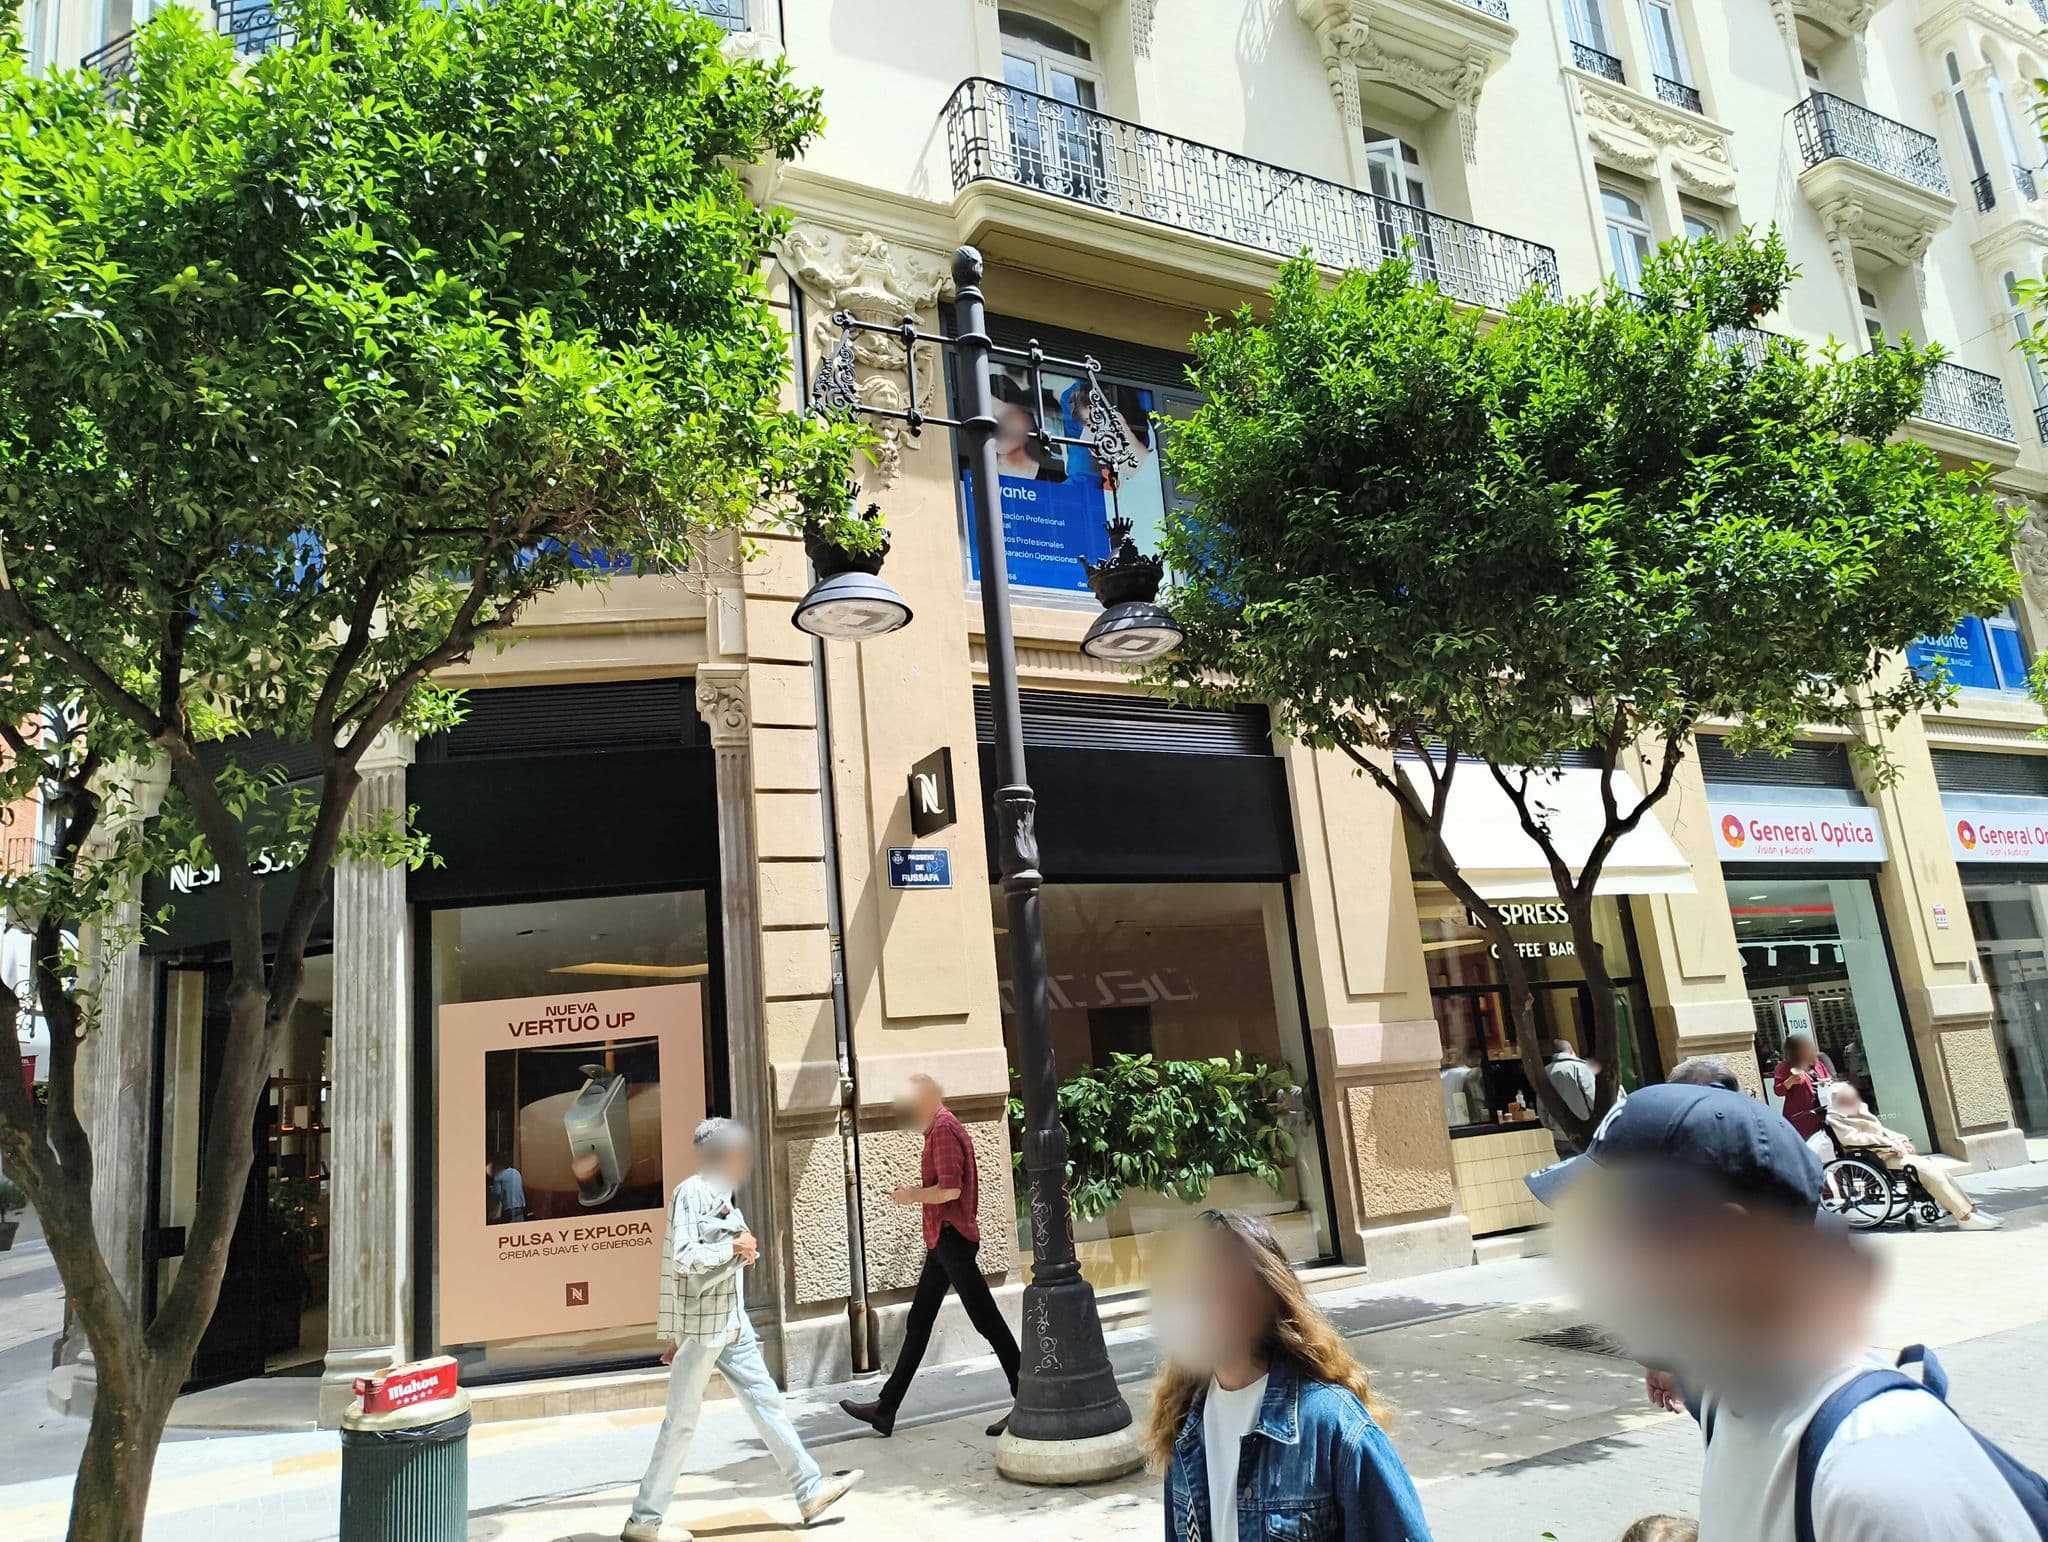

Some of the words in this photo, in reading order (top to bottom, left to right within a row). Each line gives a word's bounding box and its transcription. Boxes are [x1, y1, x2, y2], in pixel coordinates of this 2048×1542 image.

[1750, 820, 1818, 842] General
[1979, 825, 2033, 844] General
[901, 873, 940, 882] RUSSAFA
[1548, 941, 1576, 956] BAR
[545, 1002, 598, 1017] NUEVA
[508, 1015, 600, 1037] VERTUO
[605, 1012, 636, 1029] UP
[1789, 1018, 1808, 1029] TOUS
[498, 1232, 554, 1249] PULSA
[558, 1230, 570, 1242] Y
[574, 1222, 653, 1241] EXPLORA
[498, 1248, 541, 1261] CREMA
[542, 1244, 579, 1256] SUAVE
[581, 1243, 590, 1252] Y
[591, 1237, 653, 1251] GENEROSA
